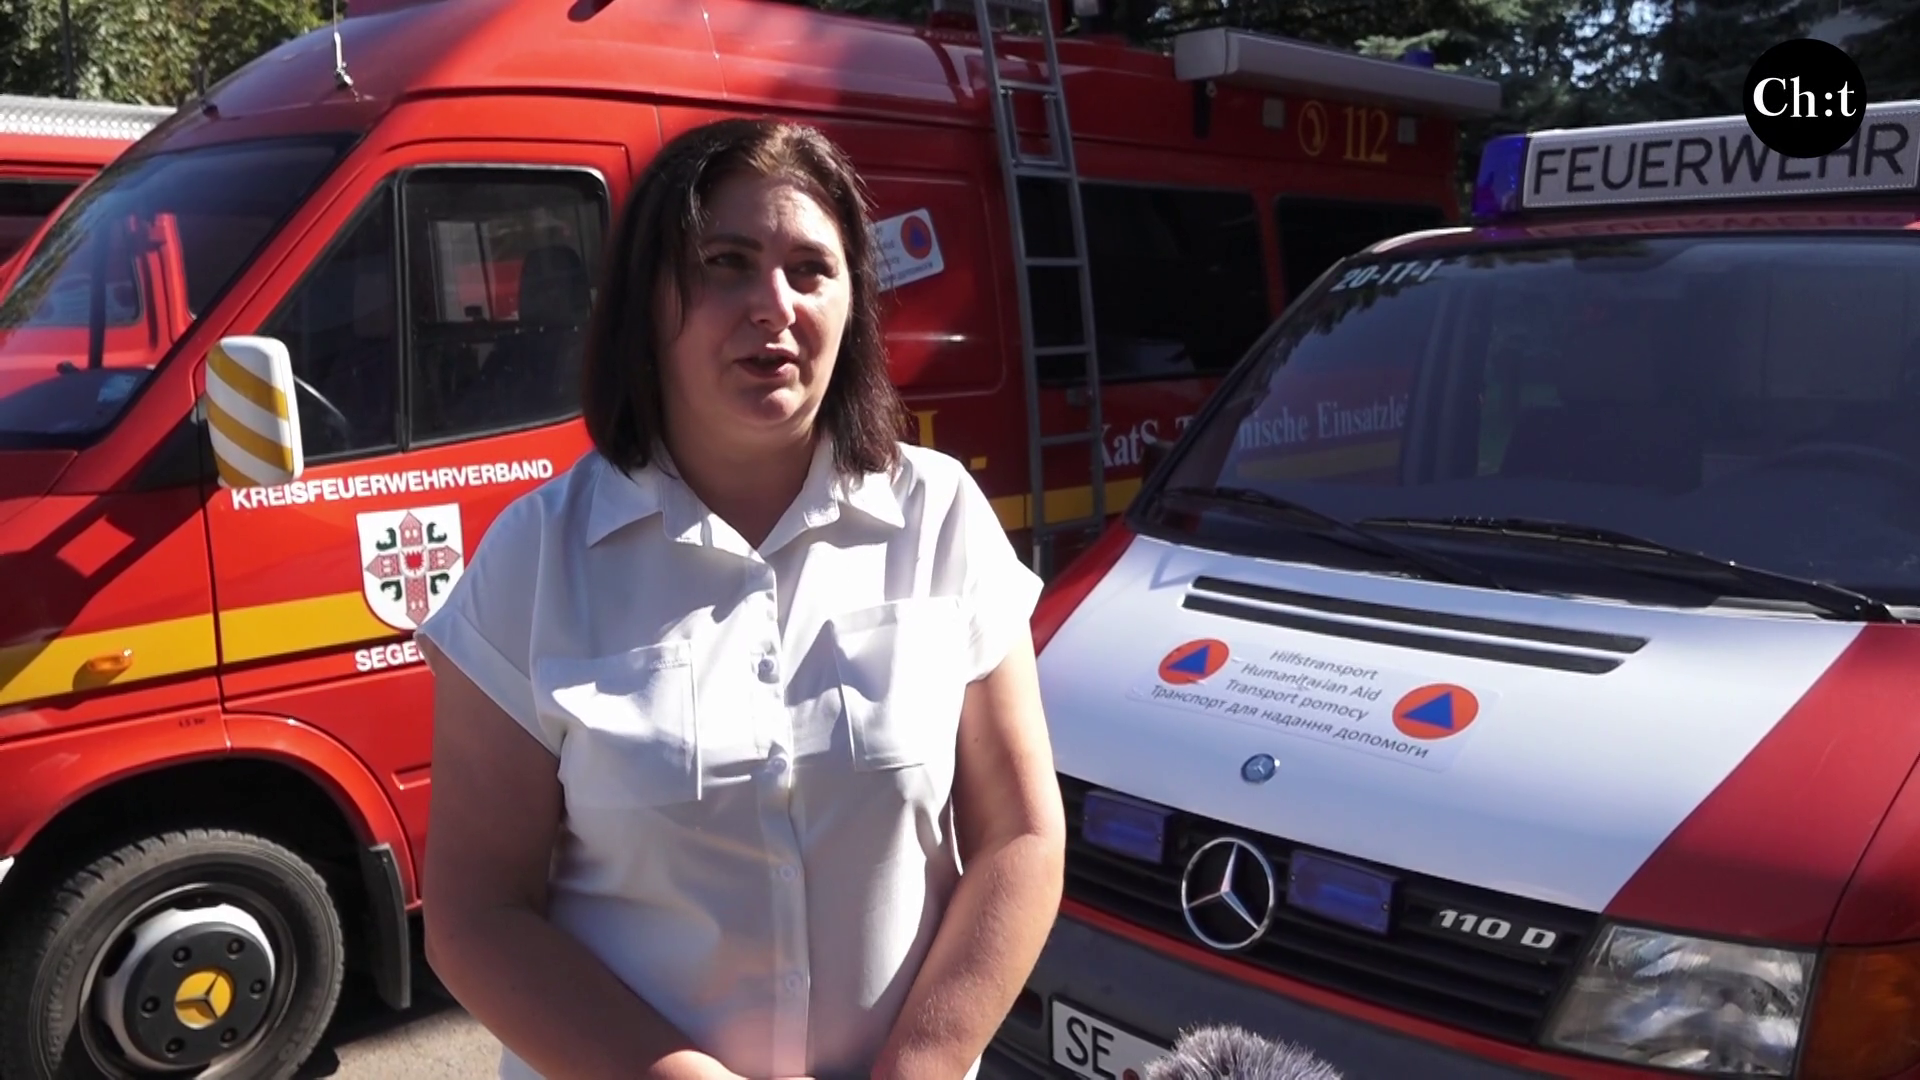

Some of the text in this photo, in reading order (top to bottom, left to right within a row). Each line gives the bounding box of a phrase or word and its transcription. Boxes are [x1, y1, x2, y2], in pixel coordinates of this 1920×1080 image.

[1343, 106, 1389, 163] 112
[231, 458, 553, 510] KREISFEUERWEHRVERBAND
[1241, 662, 1382, 702] Humanitarian Aid
[1269, 650, 1378, 681] Hilfstransport
[1150, 684, 1429, 759] Транспорт для надання допомоги
[1225, 679, 1370, 722] Transport pomocy
[1439, 909, 1556, 949] 110 D
[1066, 1016, 1117, 1080] SE
